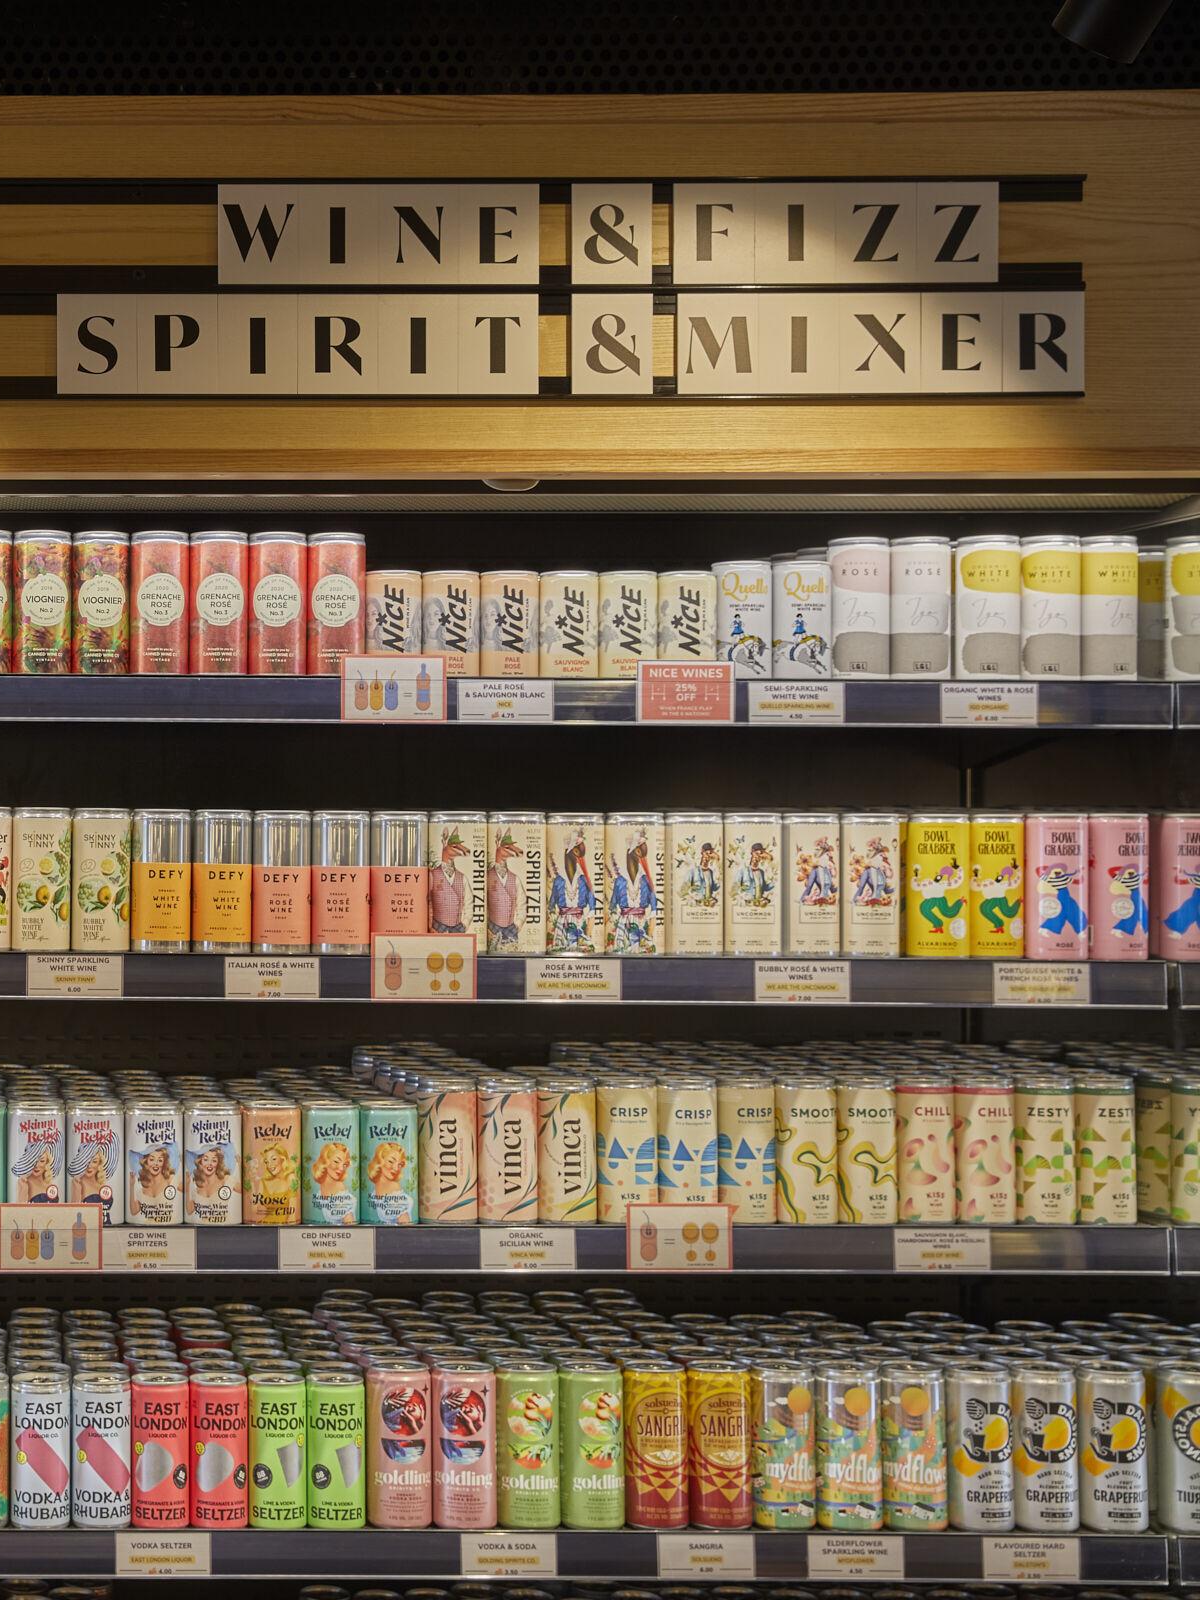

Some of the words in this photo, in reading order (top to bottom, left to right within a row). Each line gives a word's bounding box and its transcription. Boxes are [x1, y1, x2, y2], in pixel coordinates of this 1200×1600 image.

[223, 204, 518, 264] WINE
[584, 203, 639, 267] &
[696, 204, 981, 262] FIZZ
[77, 315, 520, 376] SPIRIT
[586, 314, 640, 377] &
[686, 313, 1068, 374] MIXER
[141, 593, 181, 601] GRENACHE
[200, 593, 240, 601] GRENACHE
[150, 600, 172, 608] ROSÉ
[210, 600, 231, 608] ROSÉ
[649, 669, 678, 678] NICE
[682, 669, 723, 678] WINES
[675, 684, 697, 692] 25%
[924, 831, 950, 842] BOWL
[918, 843, 956, 854] GRABBER
[149, 870, 183, 879] DEFY
[209, 871, 244, 880] DEFY
[473, 850, 485, 923] SPRITZER
[610, 1108, 648, 1117] CRISP
[915, 1107, 951, 1116] CHILL
[1028, 1108, 1069, 1117] ZESTY
[254, 1124, 292, 1139] Rebel
[434, 1119, 458, 1194] vinca
[26, 1402, 62, 1414] EAST
[144, 1403, 180, 1415] EAST
[15, 1416, 69, 1430] LONDON
[134, 1416, 187, 1431] LONDON
[434, 1470, 492, 1487] goldling
[136, 1507, 186, 1520] SELTZER
[253, 1506, 304, 1520] SELTZER
